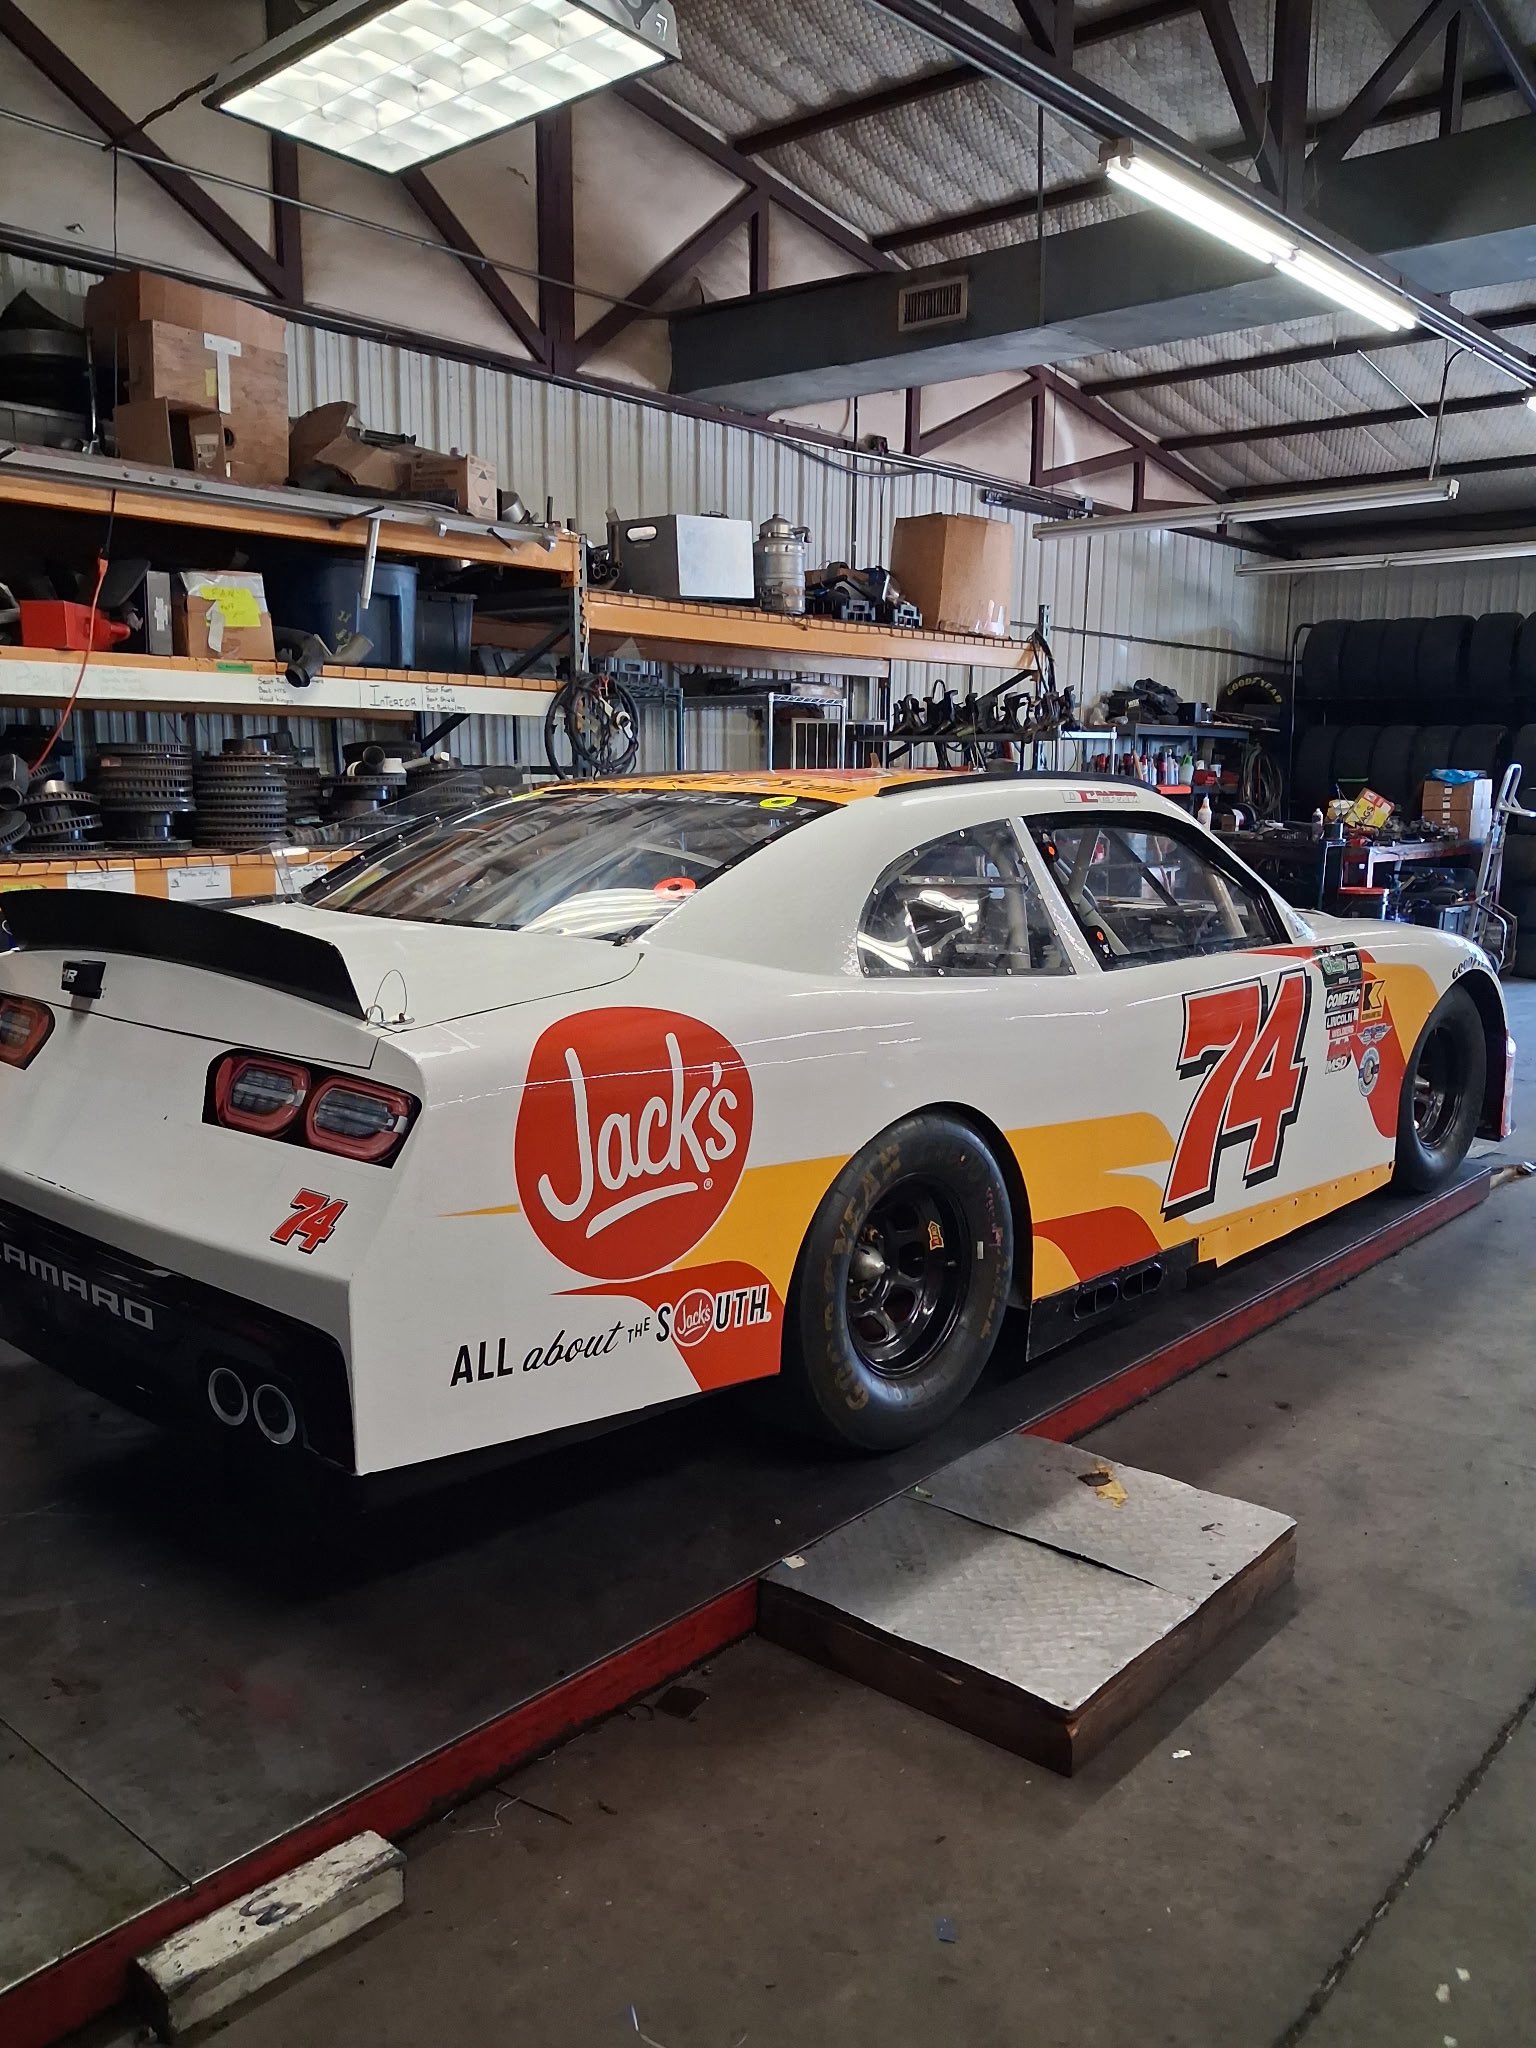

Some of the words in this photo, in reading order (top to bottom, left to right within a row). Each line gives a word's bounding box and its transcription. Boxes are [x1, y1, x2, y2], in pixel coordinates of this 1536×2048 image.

[1227, 676, 1282, 703] GOODYEAR
[1326, 989, 1361, 1009] COMETIC
[1326, 1012, 1353, 1029] LINCOLN
[1161, 968, 1312, 1223] 74
[1325, 1056, 1348, 1075] MSD
[537, 1031, 739, 1222] Jack's
[270, 1187, 350, 1255] 74
[0, 1241, 154, 1331] AMARO
[450, 1337, 513, 1387] ALL
[522, 1320, 624, 1373] about
[627, 1315, 650, 1344] THE
